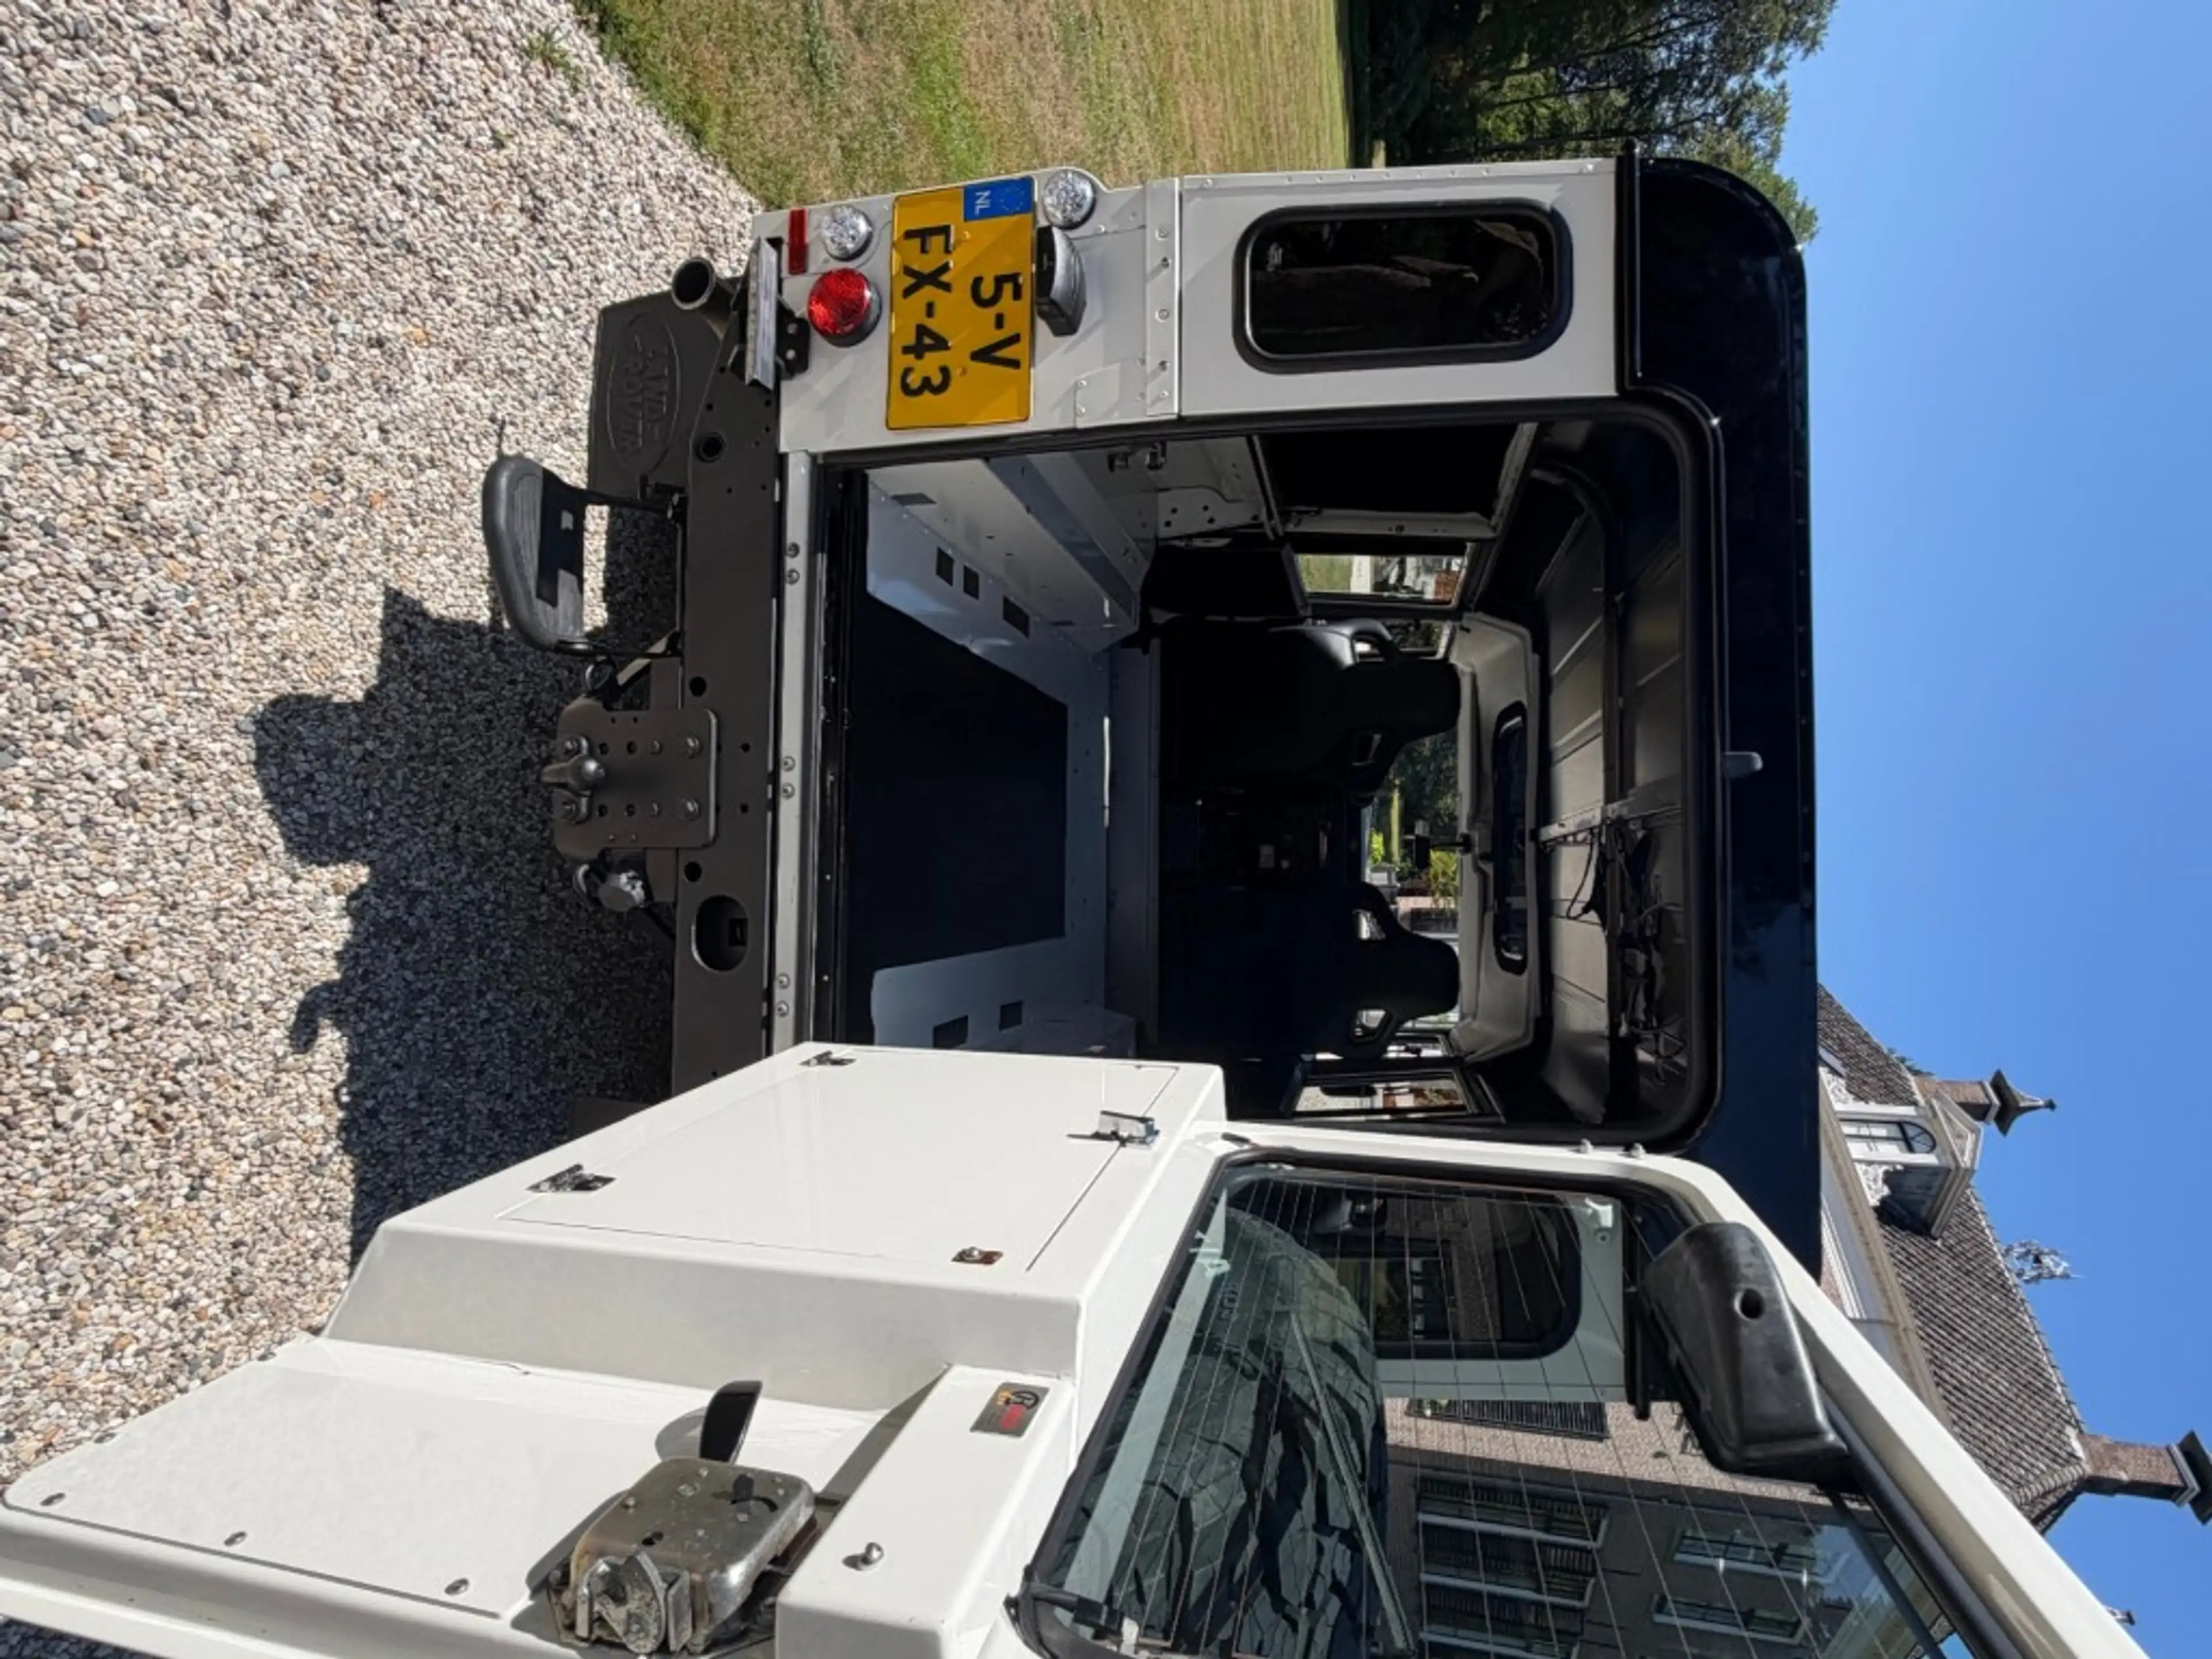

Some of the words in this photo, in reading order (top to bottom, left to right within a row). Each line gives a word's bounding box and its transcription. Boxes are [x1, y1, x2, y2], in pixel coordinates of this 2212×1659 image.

[974, 190, 991, 215] NL
[900, 224, 954, 398] FX-43
[969, 272, 1023, 370] 5-V
[620, 356, 643, 454] ROVER
[644, 346, 668, 420] LAND
